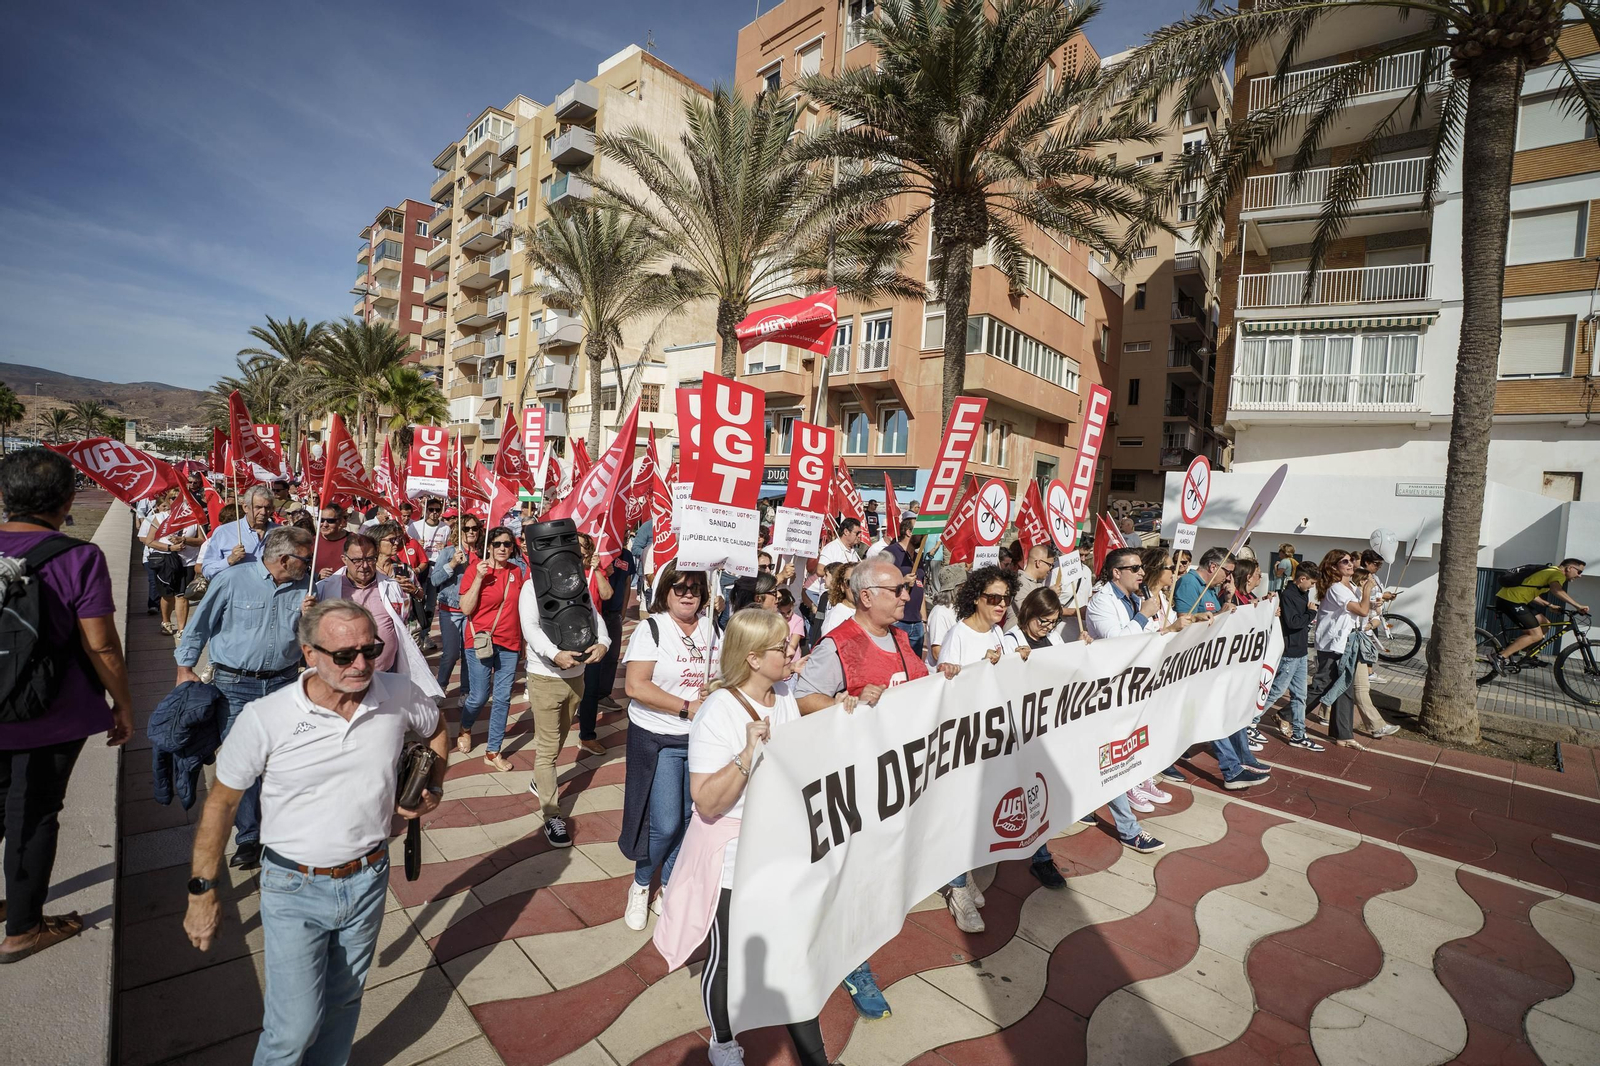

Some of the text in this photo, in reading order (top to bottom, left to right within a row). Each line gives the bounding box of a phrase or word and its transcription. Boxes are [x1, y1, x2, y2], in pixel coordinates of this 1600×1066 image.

[419, 428, 443, 477] UGT
[712, 383, 754, 504] UGT
[797, 428, 827, 508] UGT
[925, 402, 981, 512] CCOO
[1071, 391, 1108, 518] CCOO
[709, 519, 736, 529] SANIDAD
[676, 655, 688, 663] Lo
[801, 764, 863, 864] EN
[877, 700, 1019, 822] DEFENSA
[1021, 687, 1054, 744] DE
[1054, 666, 1154, 728] NUESTRA
[1153, 636, 1226, 692] SANIDAD
[1112, 734, 1138, 759] CCOO
